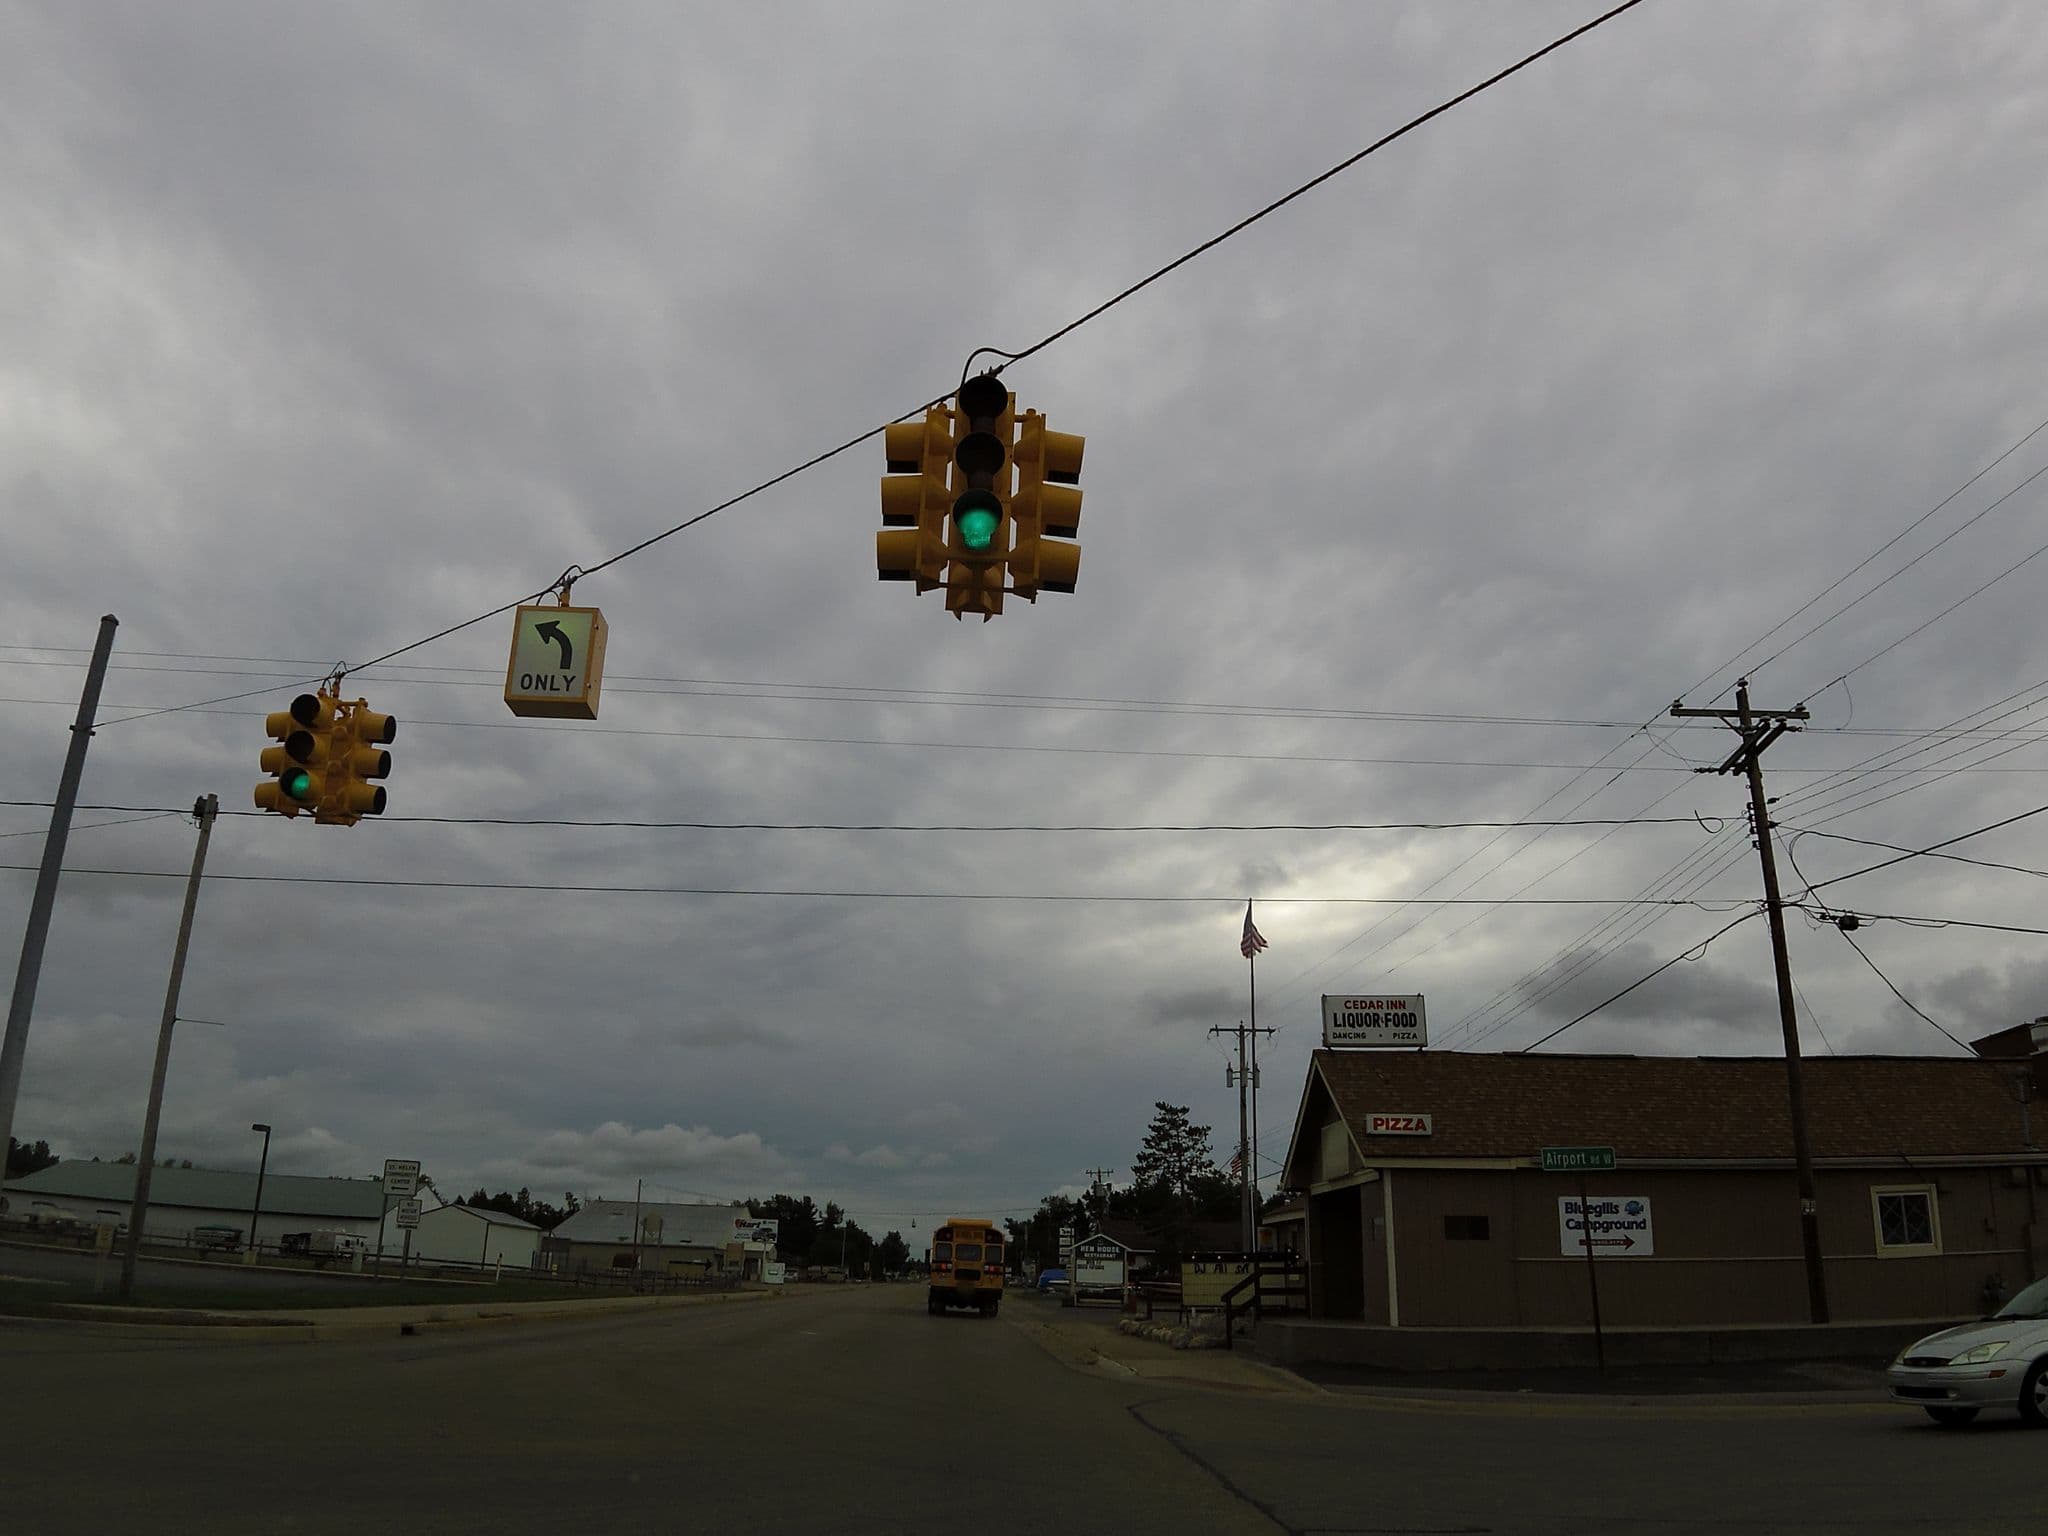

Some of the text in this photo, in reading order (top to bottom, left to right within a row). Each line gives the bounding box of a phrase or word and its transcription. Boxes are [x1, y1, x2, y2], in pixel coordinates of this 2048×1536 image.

[520, 674, 576, 692] ONLY
[1344, 1000, 1407, 1010] CEDAR INN
[1333, 1012, 1381, 1028] LIQUOR
[1385, 1012, 1417, 1028] FOOD
[1333, 1032, 1418, 1040] DANCING PIZZA
[1373, 1118, 1427, 1131] PIZZA
[1546, 1152, 1587, 1169] Airport
[1564, 1202, 1620, 1217] Bluegills
[1566, 1218, 1647, 1233] Campground
